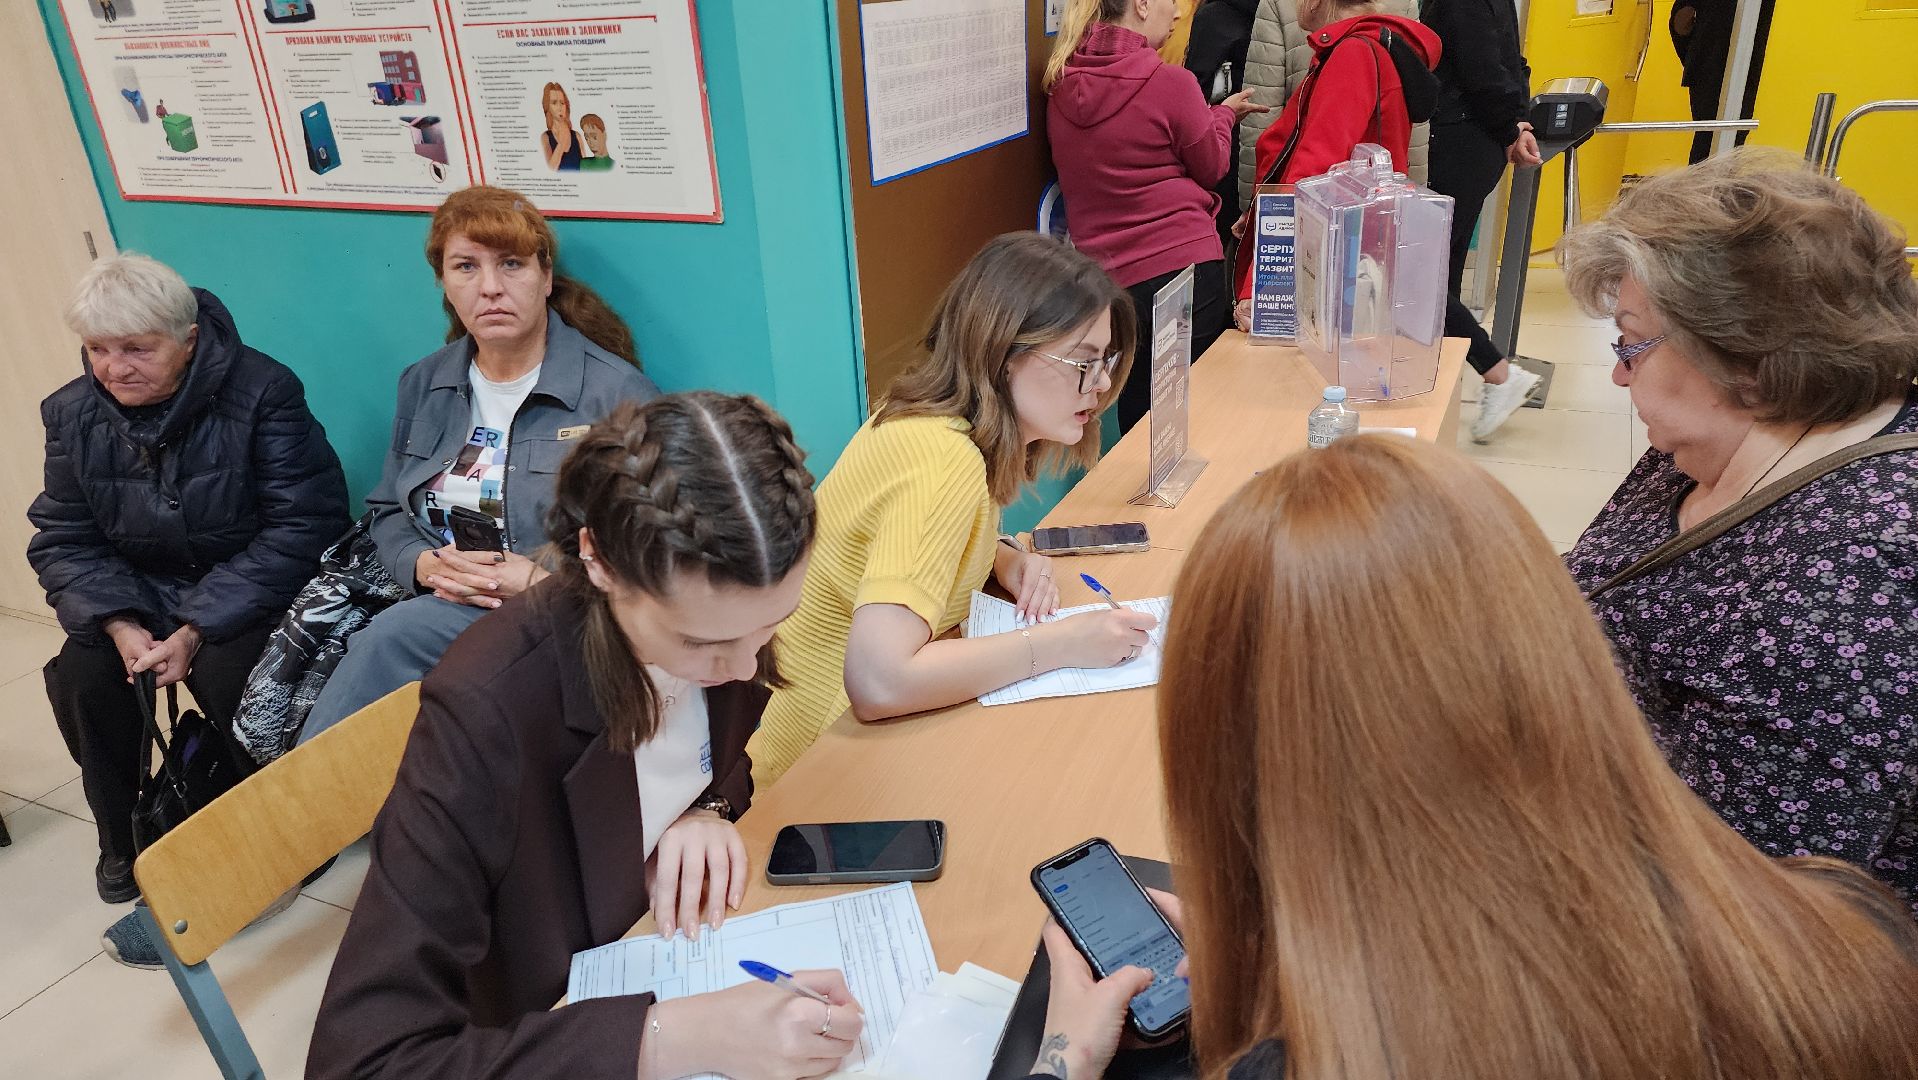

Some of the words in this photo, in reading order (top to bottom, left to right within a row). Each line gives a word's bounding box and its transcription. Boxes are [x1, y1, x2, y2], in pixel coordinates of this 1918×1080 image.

[496, 29, 515, 39] ЕСЛИ
[516, 28, 529, 38] ВАС
[531, 26, 570, 37] ЗАХВАТИЛИ
[579, 24, 622, 35] ЗАЛОЖНИКИ
[1260, 255, 1294, 263] ТЕРРИТ
[1257, 302, 1280, 310] ВАШЕ
